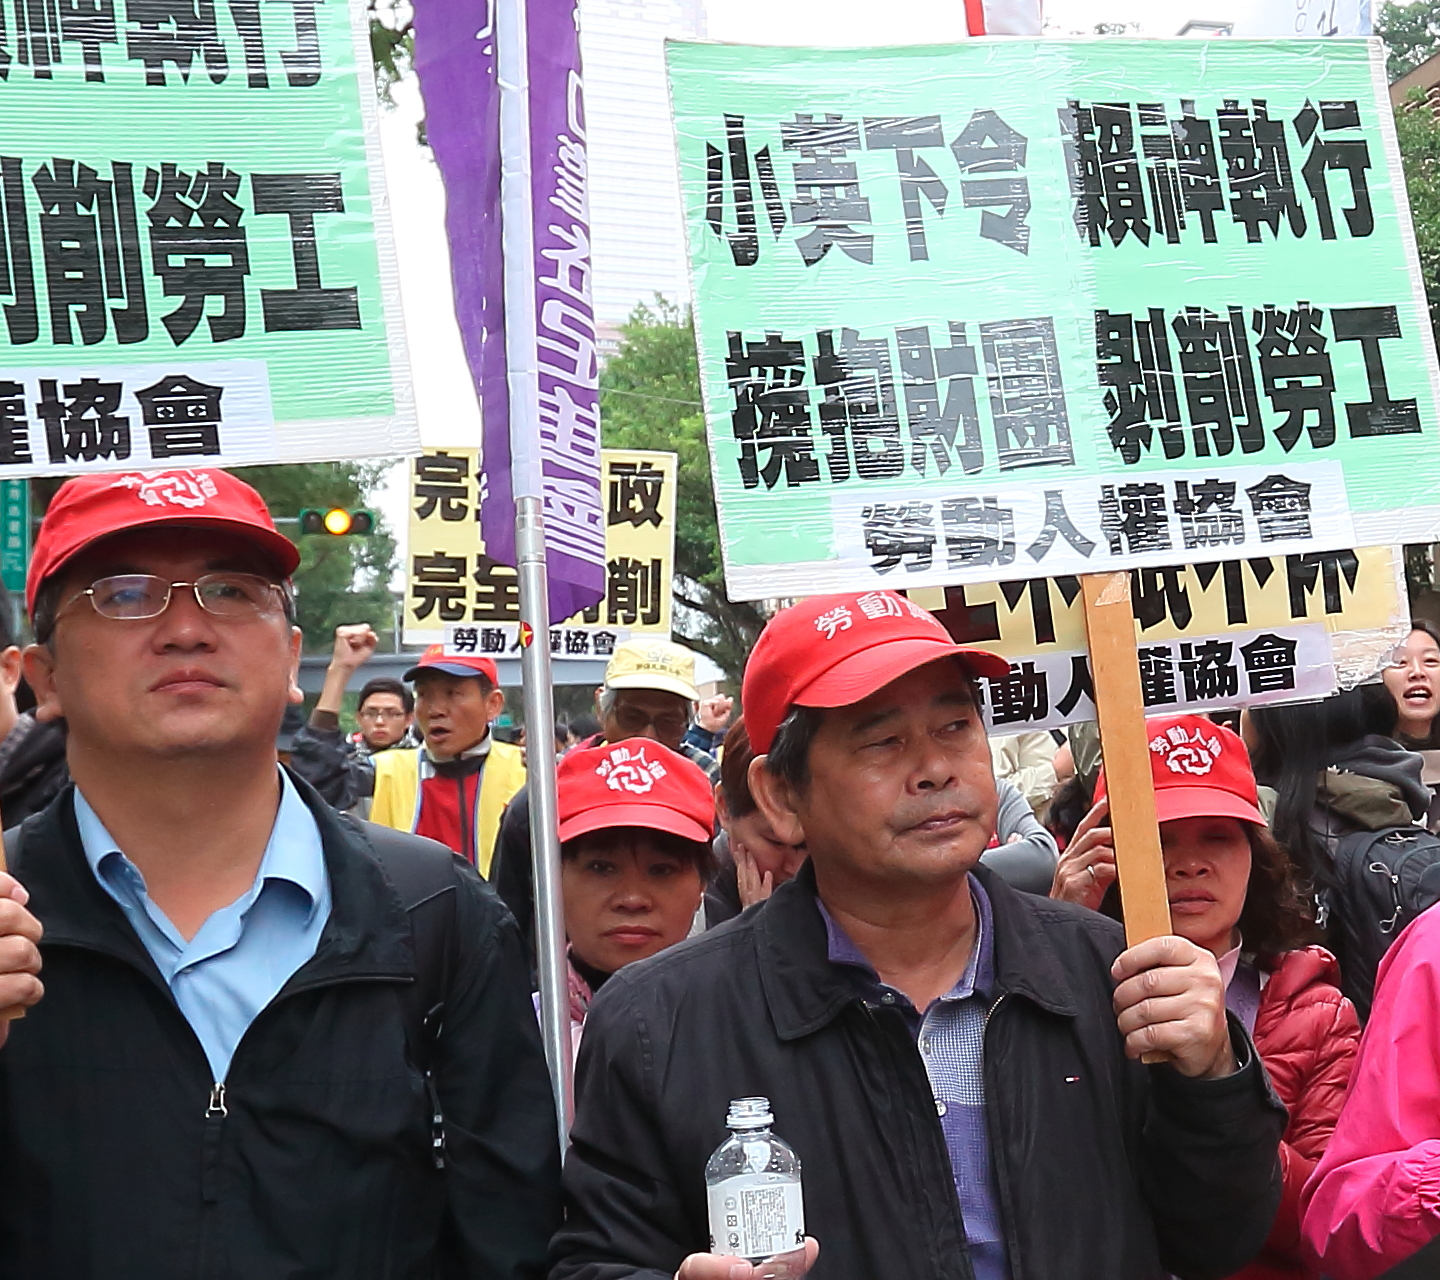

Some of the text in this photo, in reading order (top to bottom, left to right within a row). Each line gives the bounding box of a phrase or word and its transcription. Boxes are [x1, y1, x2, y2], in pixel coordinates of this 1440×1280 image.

[705, 98, 1375, 267] 小英下令 賴神執行
[725, 315, 1077, 491] 擁抱財團
[1095, 300, 1423, 466] 剝削勞工
[861, 474, 1313, 577] 勞動人權協會
[976, 632, 1298, 726] 動人權協會
